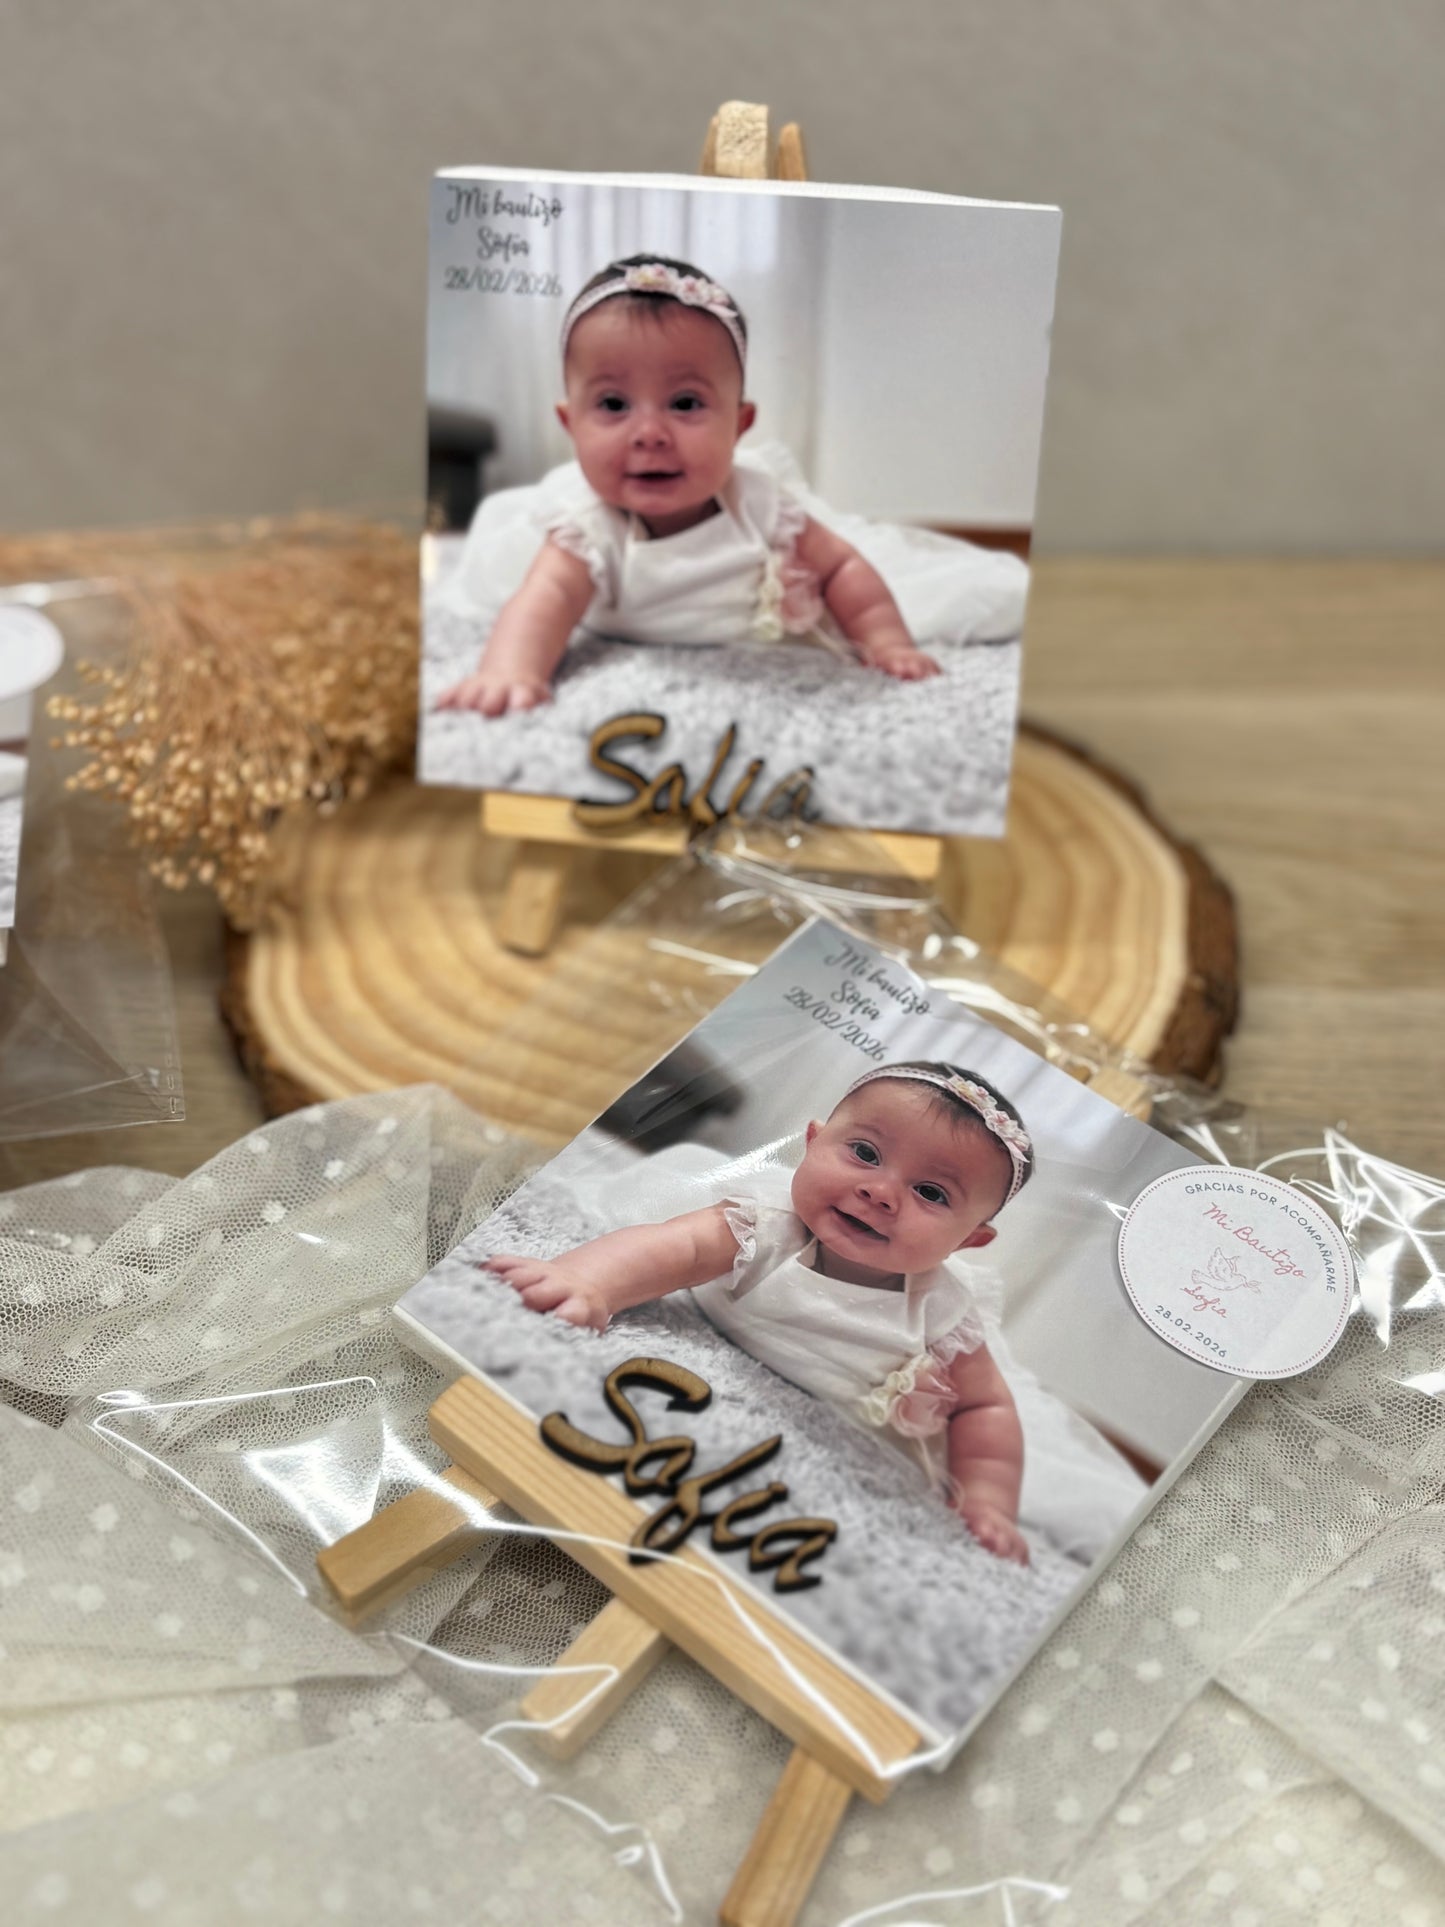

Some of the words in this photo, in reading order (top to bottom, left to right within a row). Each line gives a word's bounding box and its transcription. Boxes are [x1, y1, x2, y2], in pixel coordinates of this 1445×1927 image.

[783, 985, 889, 1062] 28/02/2026
[1185, 1182, 1245, 1195] GRACIAS
[1249, 1188, 1278, 1206] POR
[1280, 1204, 1337, 1294] ACOMPAÑARME
[1203, 1202, 1233, 1231] Mi
[1233, 1226, 1307, 1279] Bautizo
[1154, 1304, 1227, 1359] 28.02.2026
